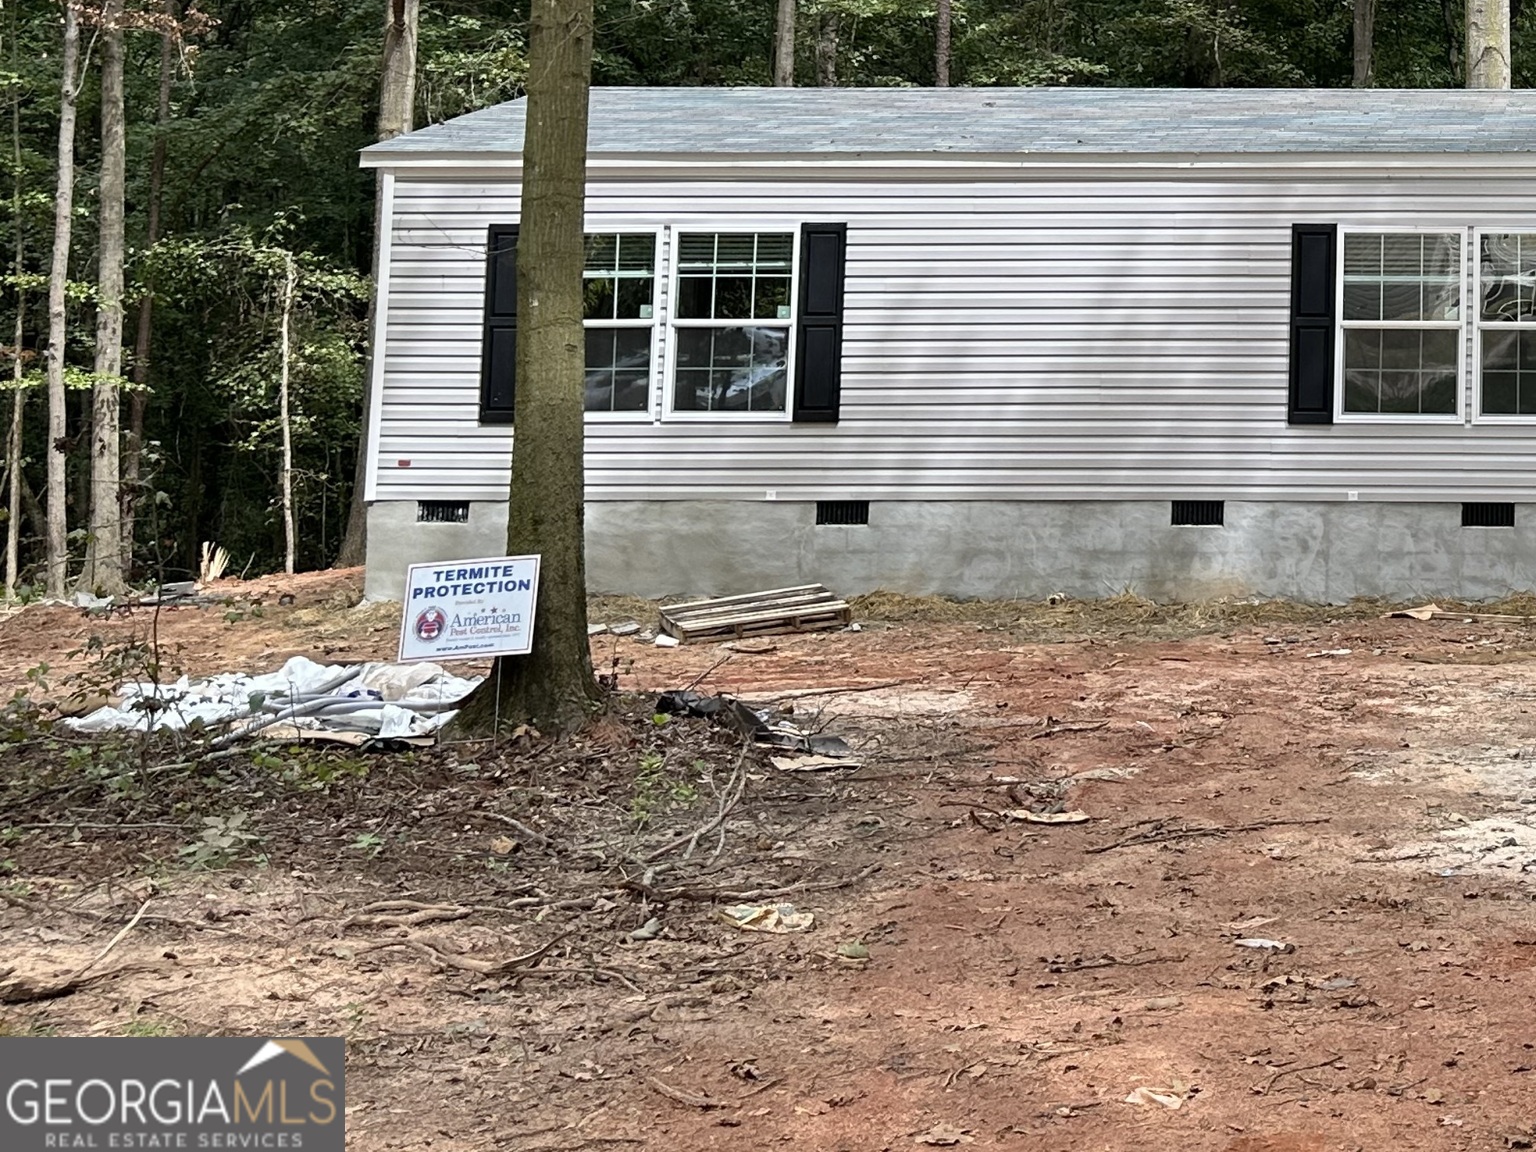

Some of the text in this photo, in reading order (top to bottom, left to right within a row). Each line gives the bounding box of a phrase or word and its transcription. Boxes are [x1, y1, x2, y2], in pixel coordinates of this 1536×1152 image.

[433, 565, 514, 582] TERMITE
[412, 579, 531, 599] PROTECTION
[450, 613, 521, 627] American
[450, 627, 468, 636] Pest
